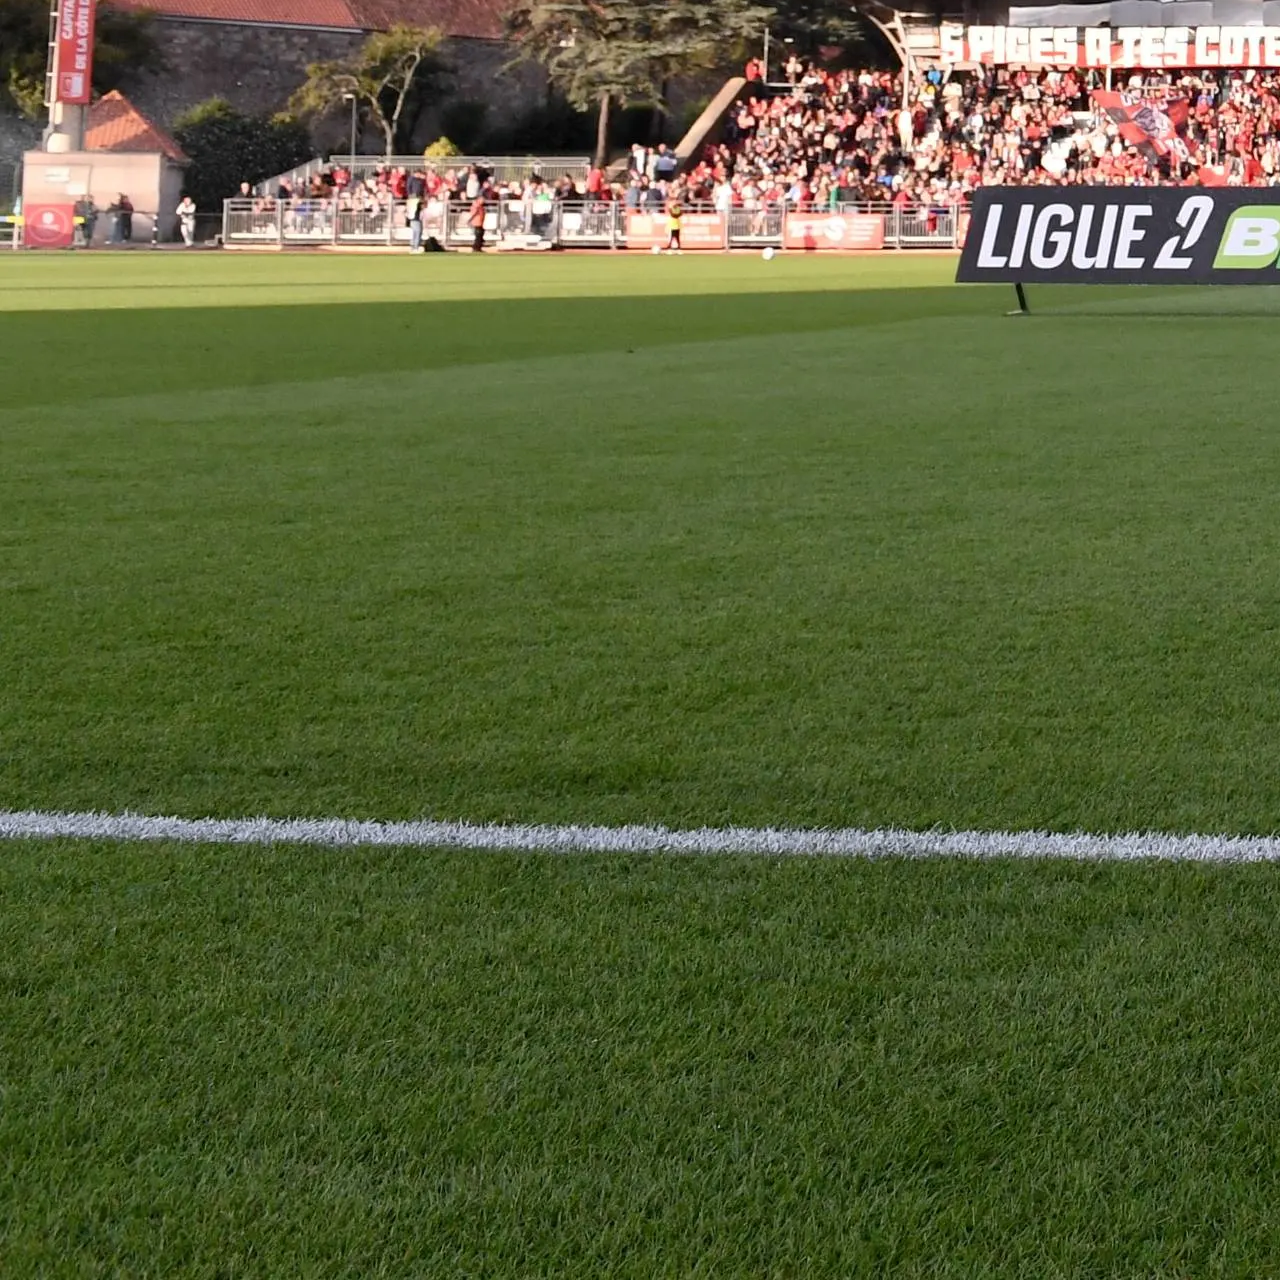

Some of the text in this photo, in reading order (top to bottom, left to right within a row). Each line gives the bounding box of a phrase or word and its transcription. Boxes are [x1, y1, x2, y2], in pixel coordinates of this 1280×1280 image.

[1118, 26, 1189, 67] TES
[976, 204, 1153, 269] LIGUE
[1153, 196, 1214, 269] 2
